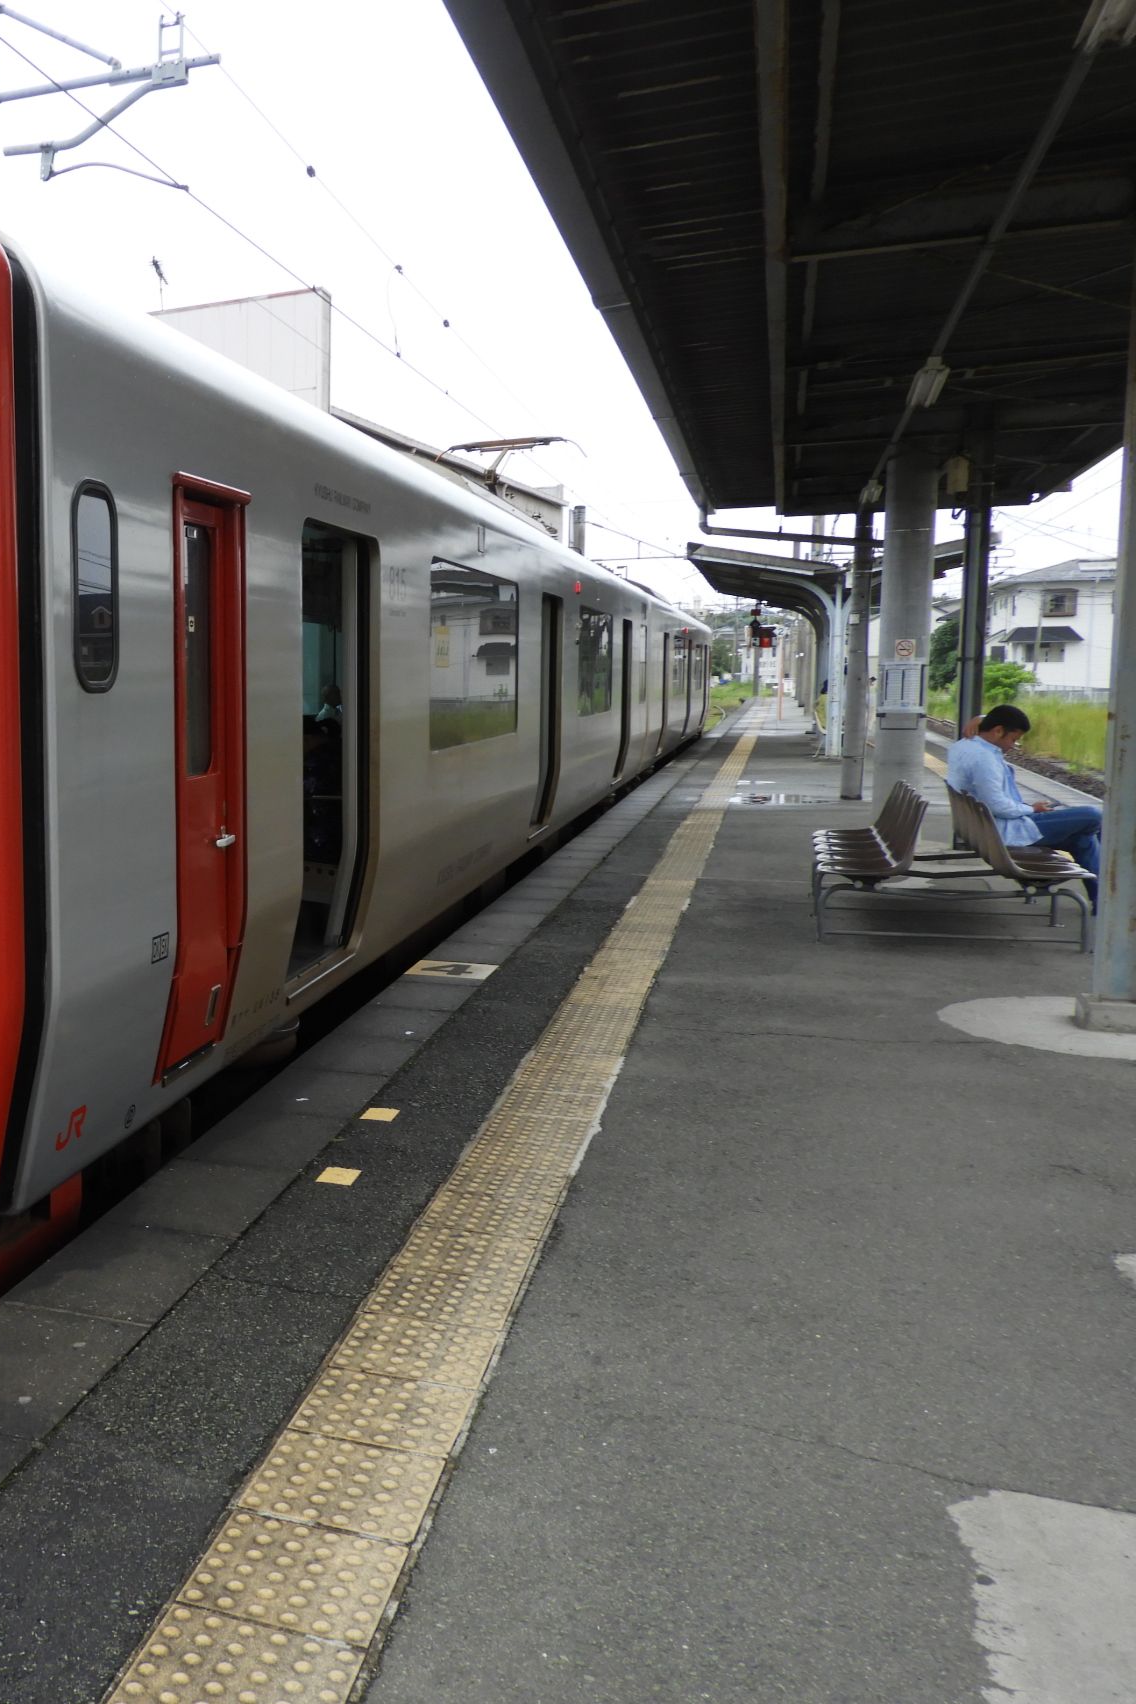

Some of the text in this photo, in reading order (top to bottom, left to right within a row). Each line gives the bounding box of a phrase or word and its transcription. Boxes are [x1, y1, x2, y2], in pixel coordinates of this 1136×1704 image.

[777, 627, 785, 636] 2
[420, 963, 473, 976] 4
[55, 1104, 87, 1152] JR
